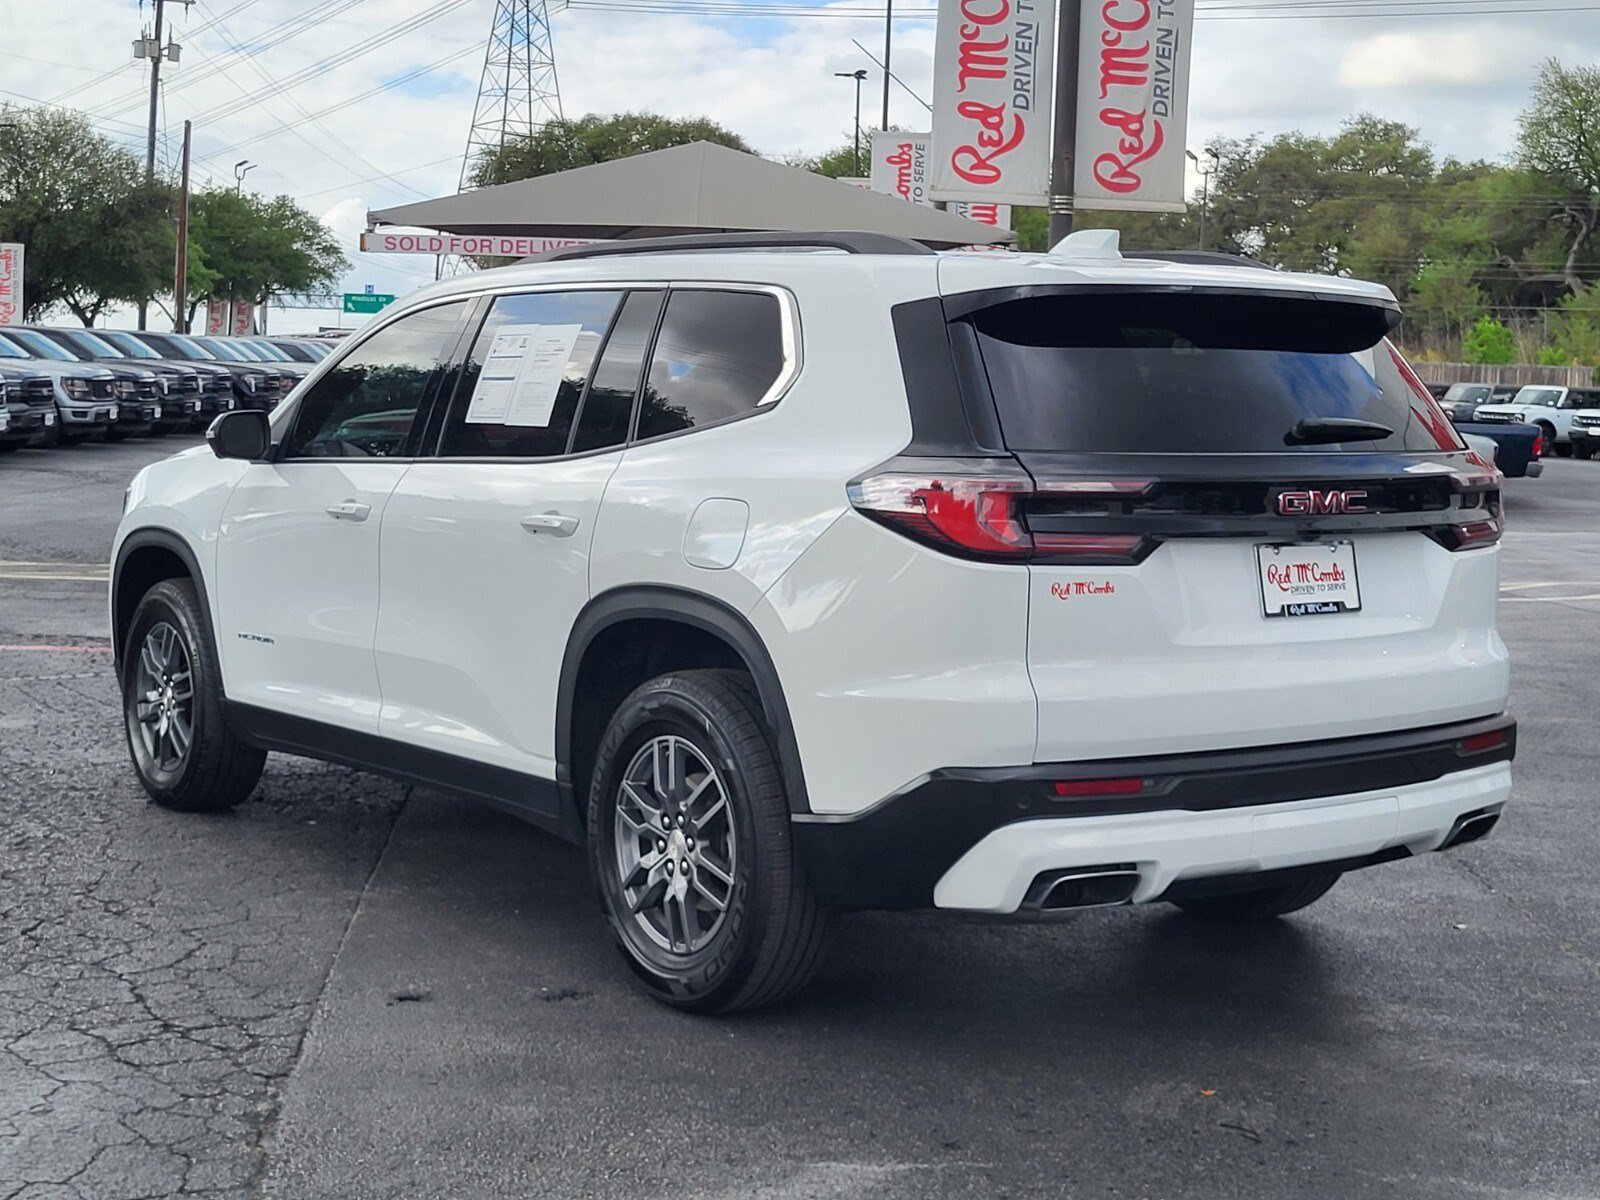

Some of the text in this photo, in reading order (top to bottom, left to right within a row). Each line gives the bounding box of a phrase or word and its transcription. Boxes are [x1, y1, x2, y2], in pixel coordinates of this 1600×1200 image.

[1013, 0, 1034, 110] DRIVEN T
[1152, 28, 1174, 117] DRIVEN
[886, 143, 913, 200] ombs
[951, 101, 1025, 185] Red
[1093, 108, 1164, 193] Red
[913, 143, 925, 204] TO SERVE
[384, 236, 443, 252] SOLD
[450, 238, 493, 253] FOR
[1278, 491, 1367, 515] GMC
[1051, 581, 1115, 600] Red McCombs
[1268, 562, 1346, 591] Red McCombs
[1291, 583, 1346, 594] DRIVEN TO SERVE
